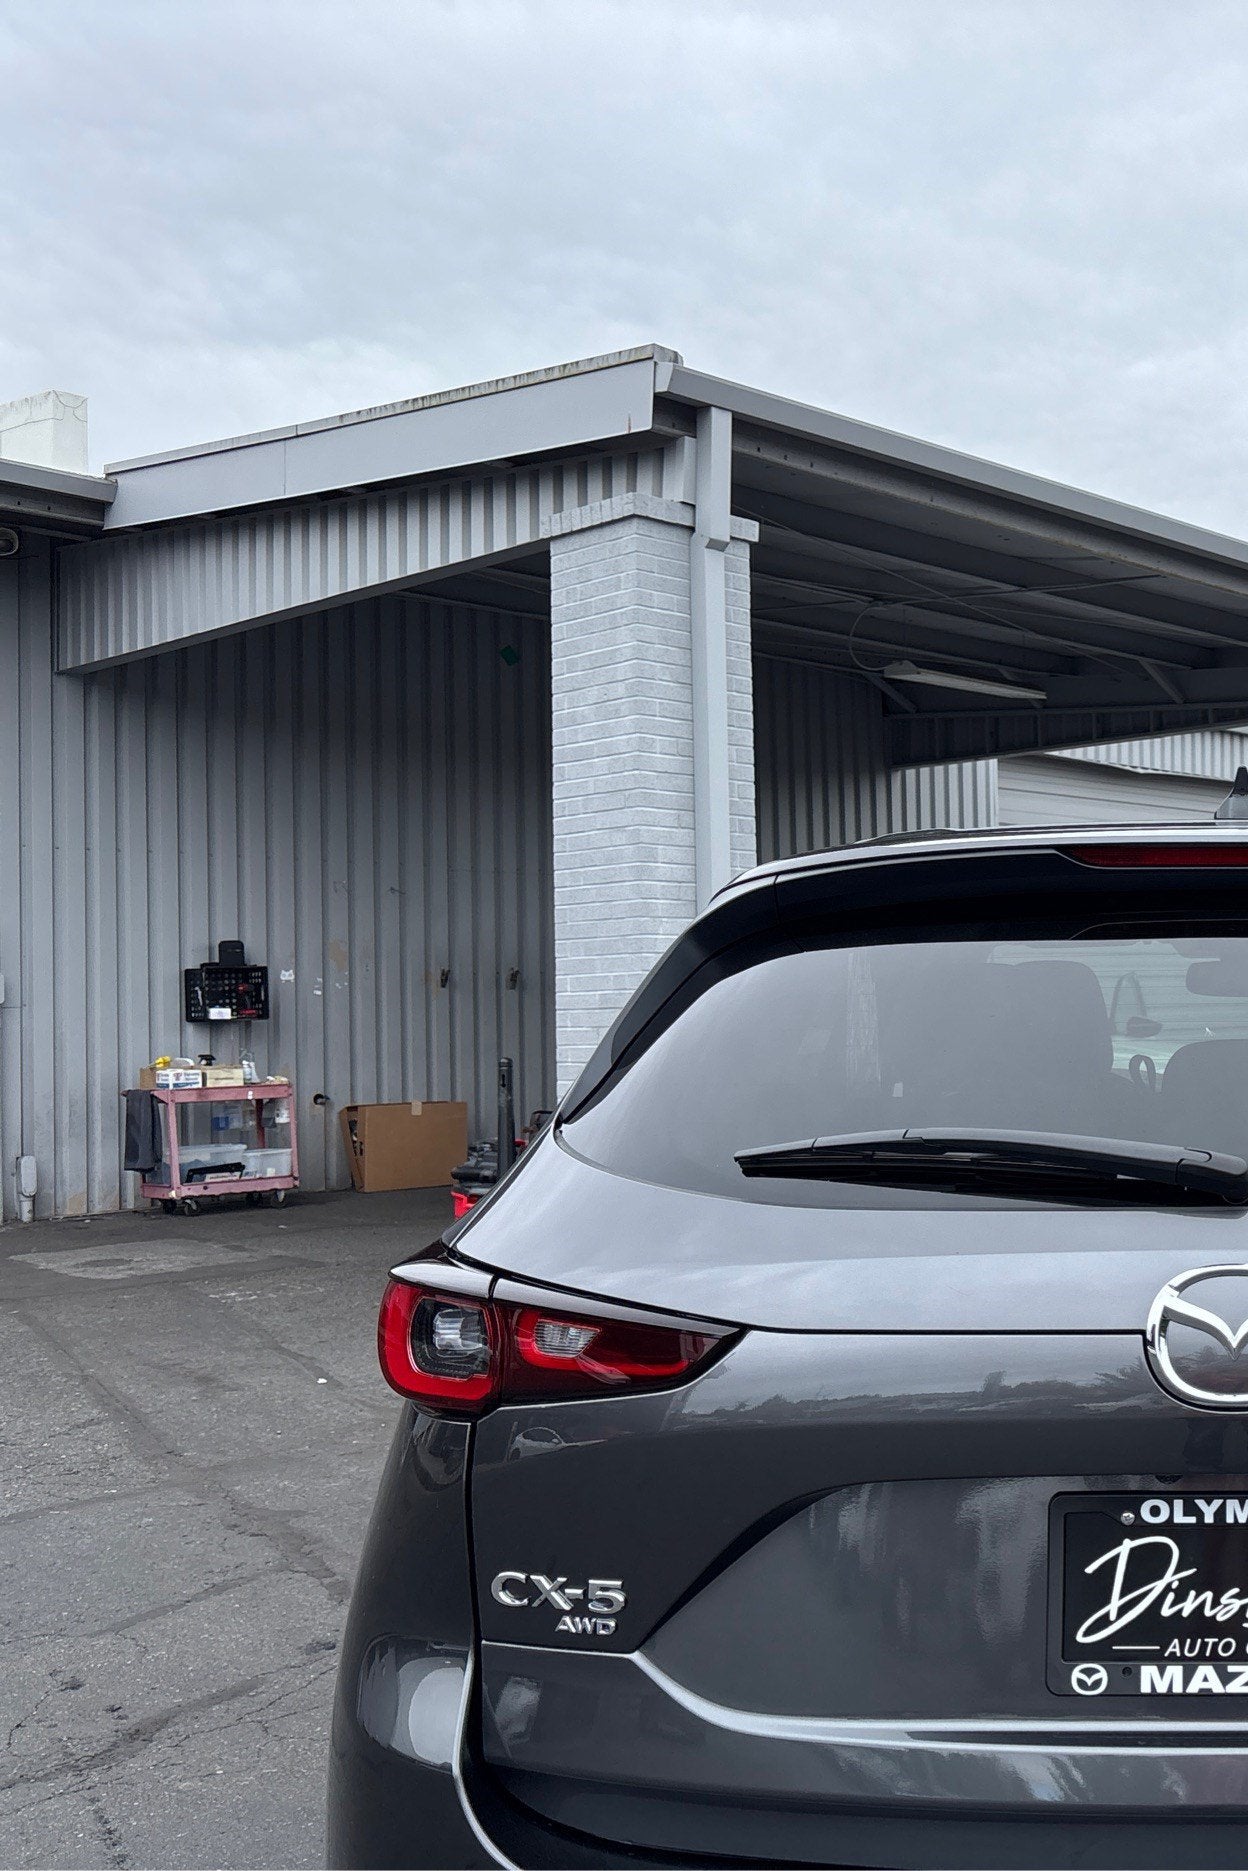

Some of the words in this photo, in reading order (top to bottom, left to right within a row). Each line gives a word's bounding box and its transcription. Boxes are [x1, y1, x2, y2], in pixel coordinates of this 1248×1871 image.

[490, 1571, 627, 1615] CX-5
[554, 1615, 618, 1636] AWD
[1163, 1637, 1238, 1658] AUTO
